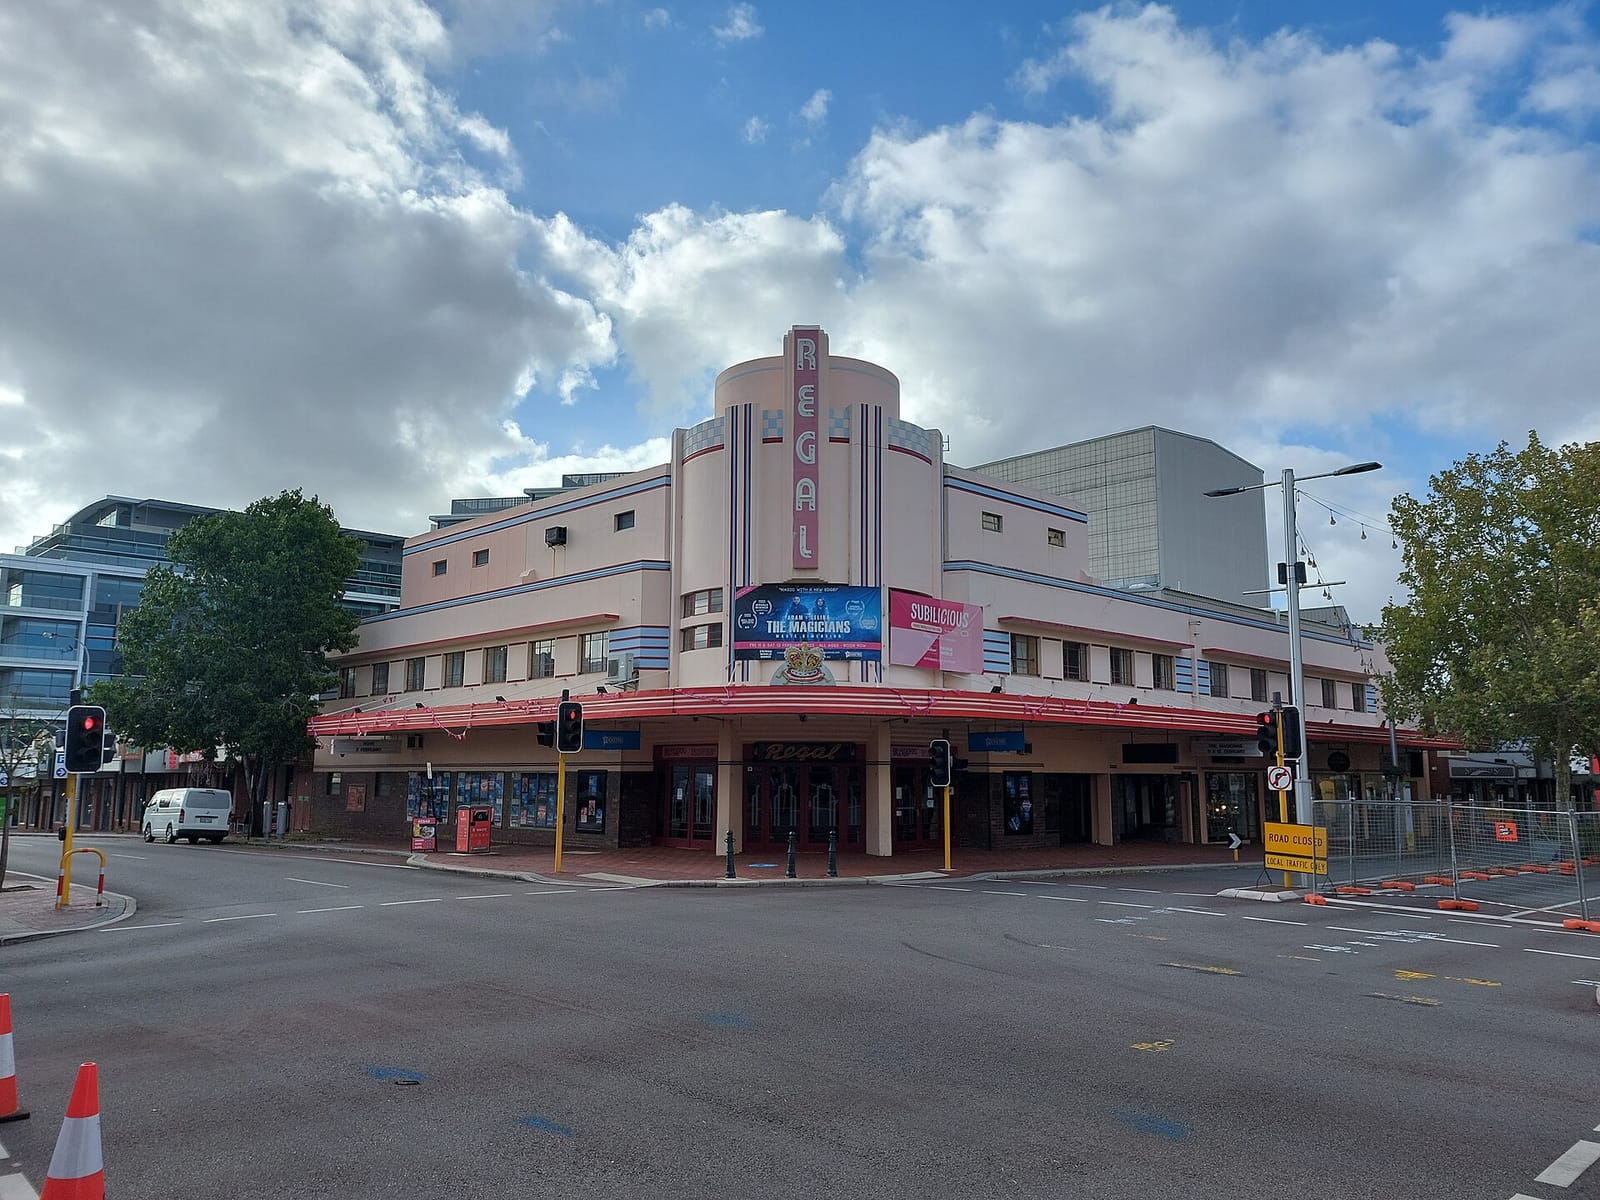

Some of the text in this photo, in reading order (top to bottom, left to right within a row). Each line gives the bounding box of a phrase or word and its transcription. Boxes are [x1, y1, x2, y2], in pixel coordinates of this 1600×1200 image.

[795, 338, 816, 558] REGAL
[910, 602, 969, 627] SUBILICIOUS
[766, 620, 785, 633] THE
[789, 620, 851, 633] MAGICIANS
[764, 743, 842, 761] Regal
[1268, 833, 1289, 843] ROAD
[1266, 856, 1284, 866] LOCAL
[1286, 859, 1308, 869] TRAFFIC
